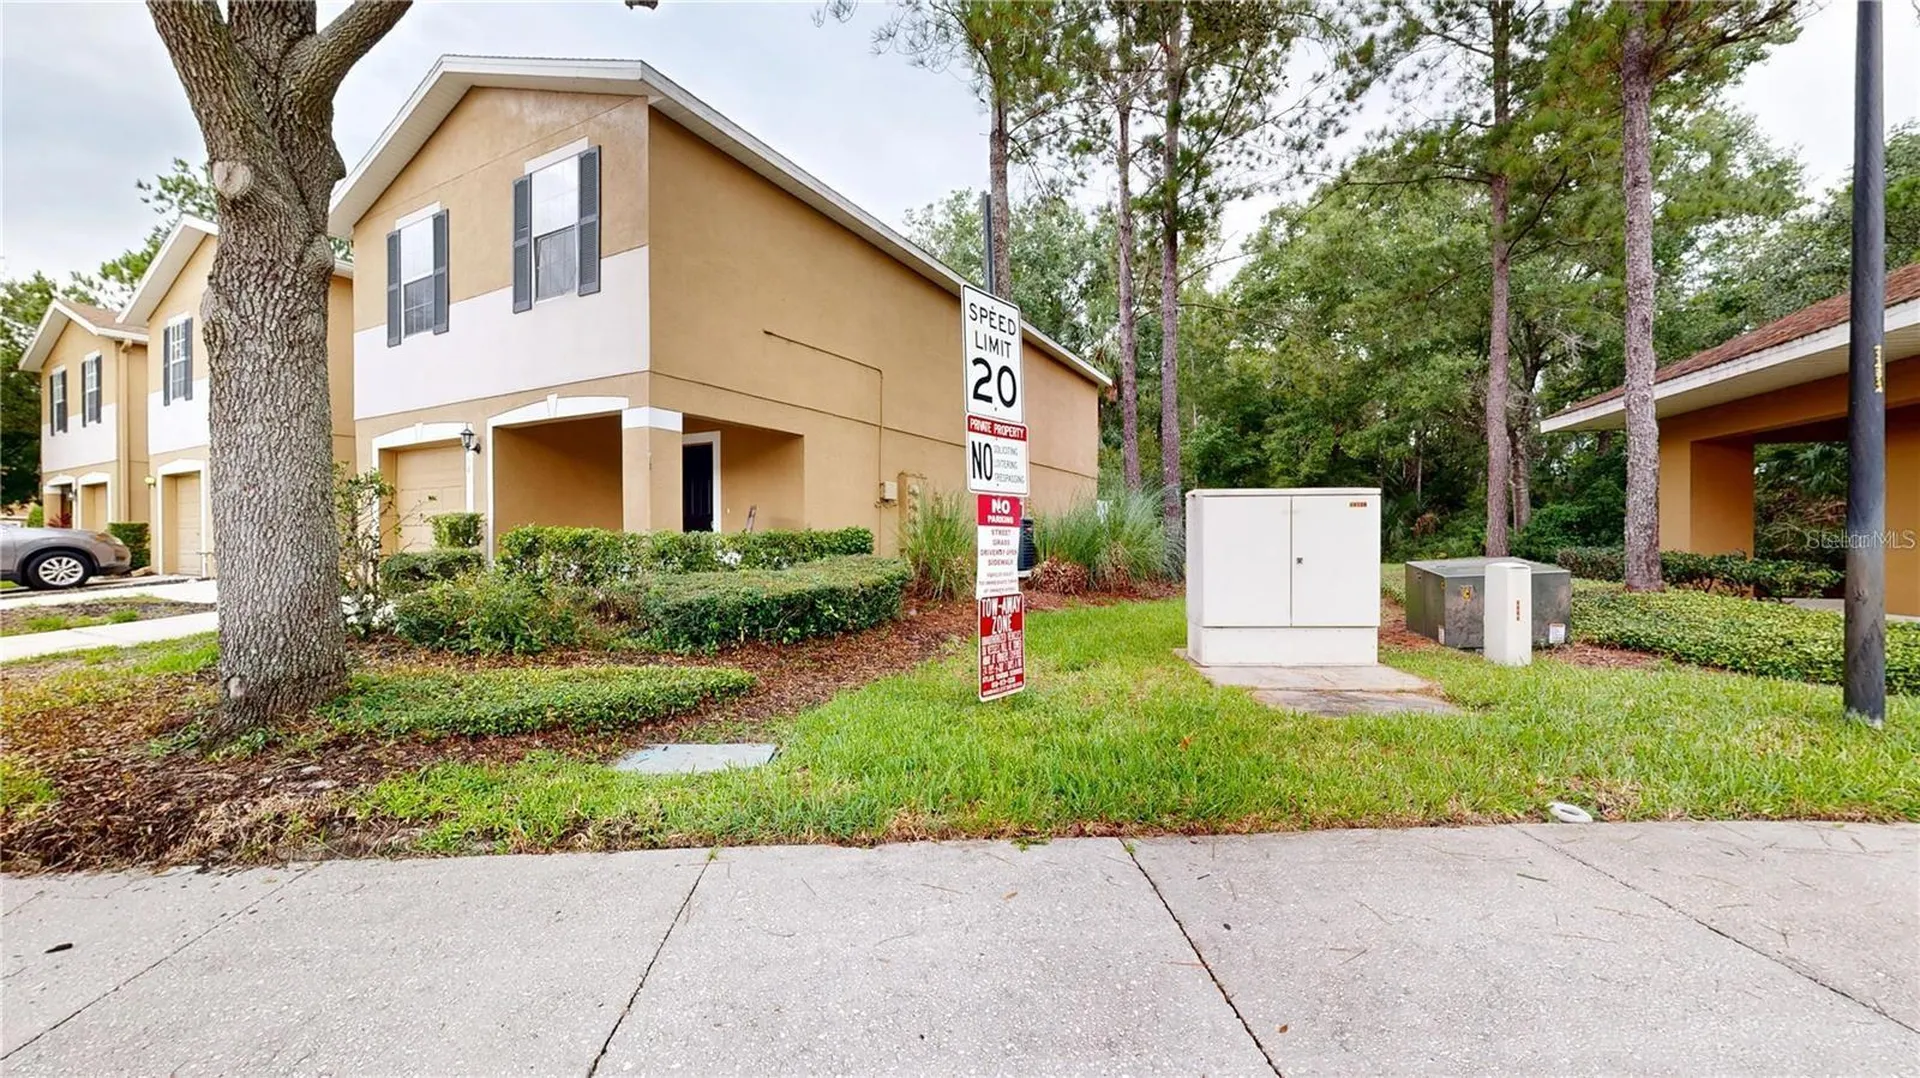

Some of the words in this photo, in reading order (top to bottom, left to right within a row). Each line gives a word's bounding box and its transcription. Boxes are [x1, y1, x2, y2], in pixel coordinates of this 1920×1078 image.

[969, 303, 1016, 335] SPEED
[975, 330, 1011, 358] LIMIT
[972, 357, 1017, 408] 20
[969, 417, 992, 434] PRIVATE
[993, 423, 1025, 438] PROPERTY
[972, 441, 993, 481] NO
[991, 498, 1011, 515] NO
[987, 515, 1014, 524] PARKING
[987, 559, 1014, 567] SIDEWALK
[982, 595, 1021, 617] TOW-AWAY
[992, 614, 1013, 634] ZONE
